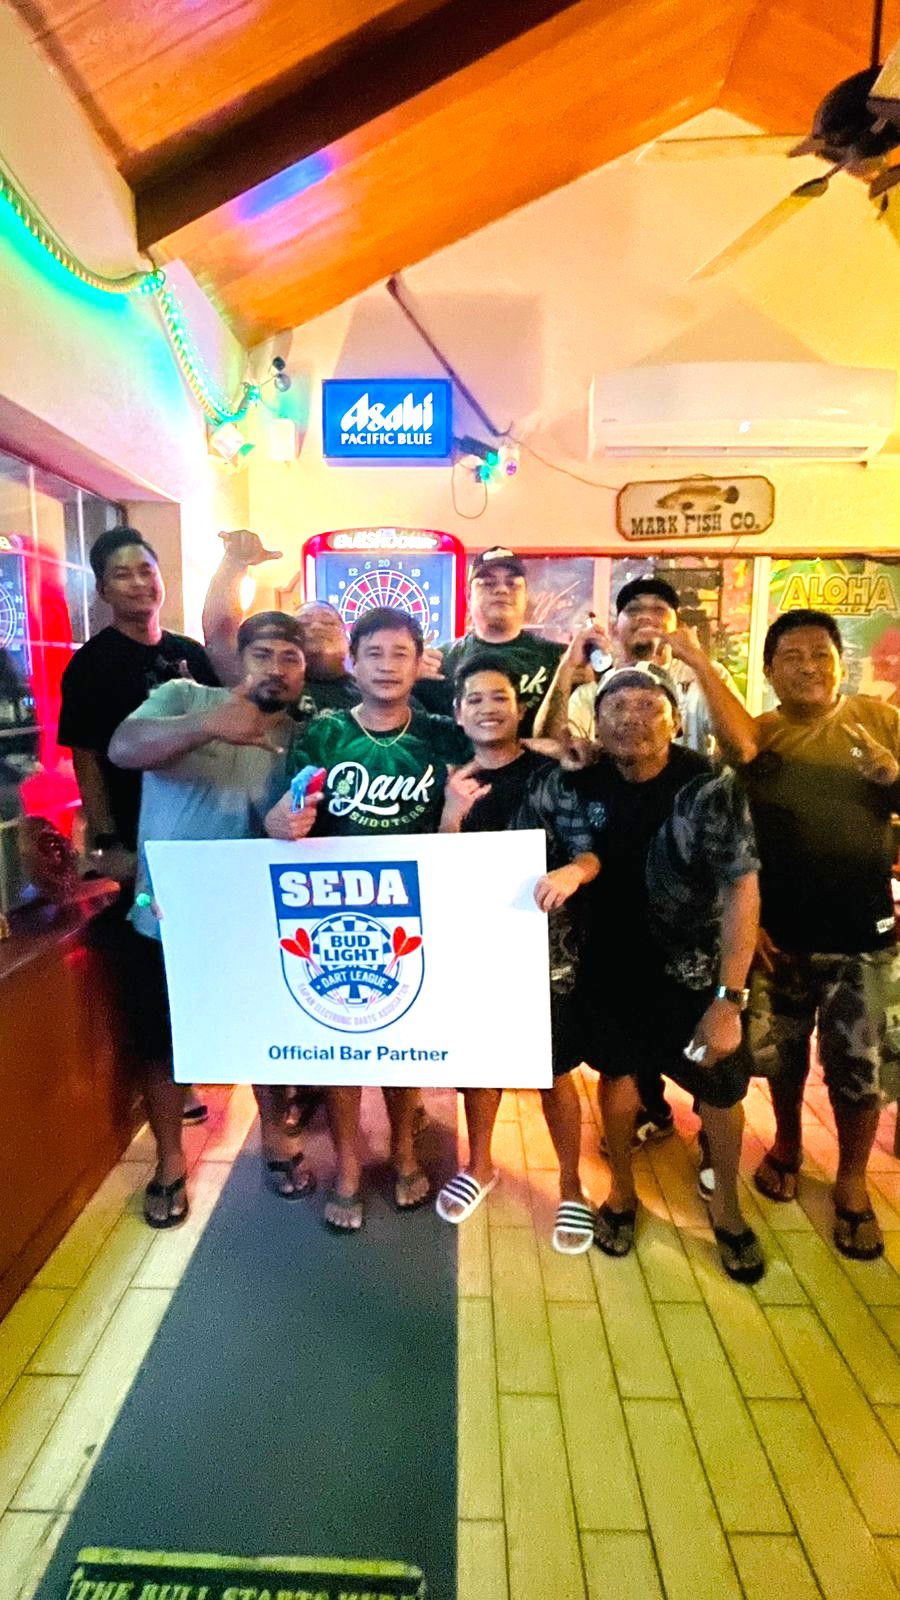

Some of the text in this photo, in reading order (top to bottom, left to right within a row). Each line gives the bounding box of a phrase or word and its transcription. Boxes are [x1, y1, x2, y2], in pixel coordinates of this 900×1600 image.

[340, 392, 433, 433] Asahi
[340, 432, 433, 445] PACIFIC BLUE
[631, 512, 761, 536] MARK FISH CO.
[378, 559, 390, 568] 20
[781, 575, 897, 611] ALOHA
[349, 804, 426, 829] SHOOTERS
[279, 868, 410, 908] SEDA
[331, 935, 371, 948] BUD
[324, 948, 379, 962] LIGHT
[321, 970, 387, 988] DART LEAGUE
[268, 1045, 449, 1061] Official Bar Partner
